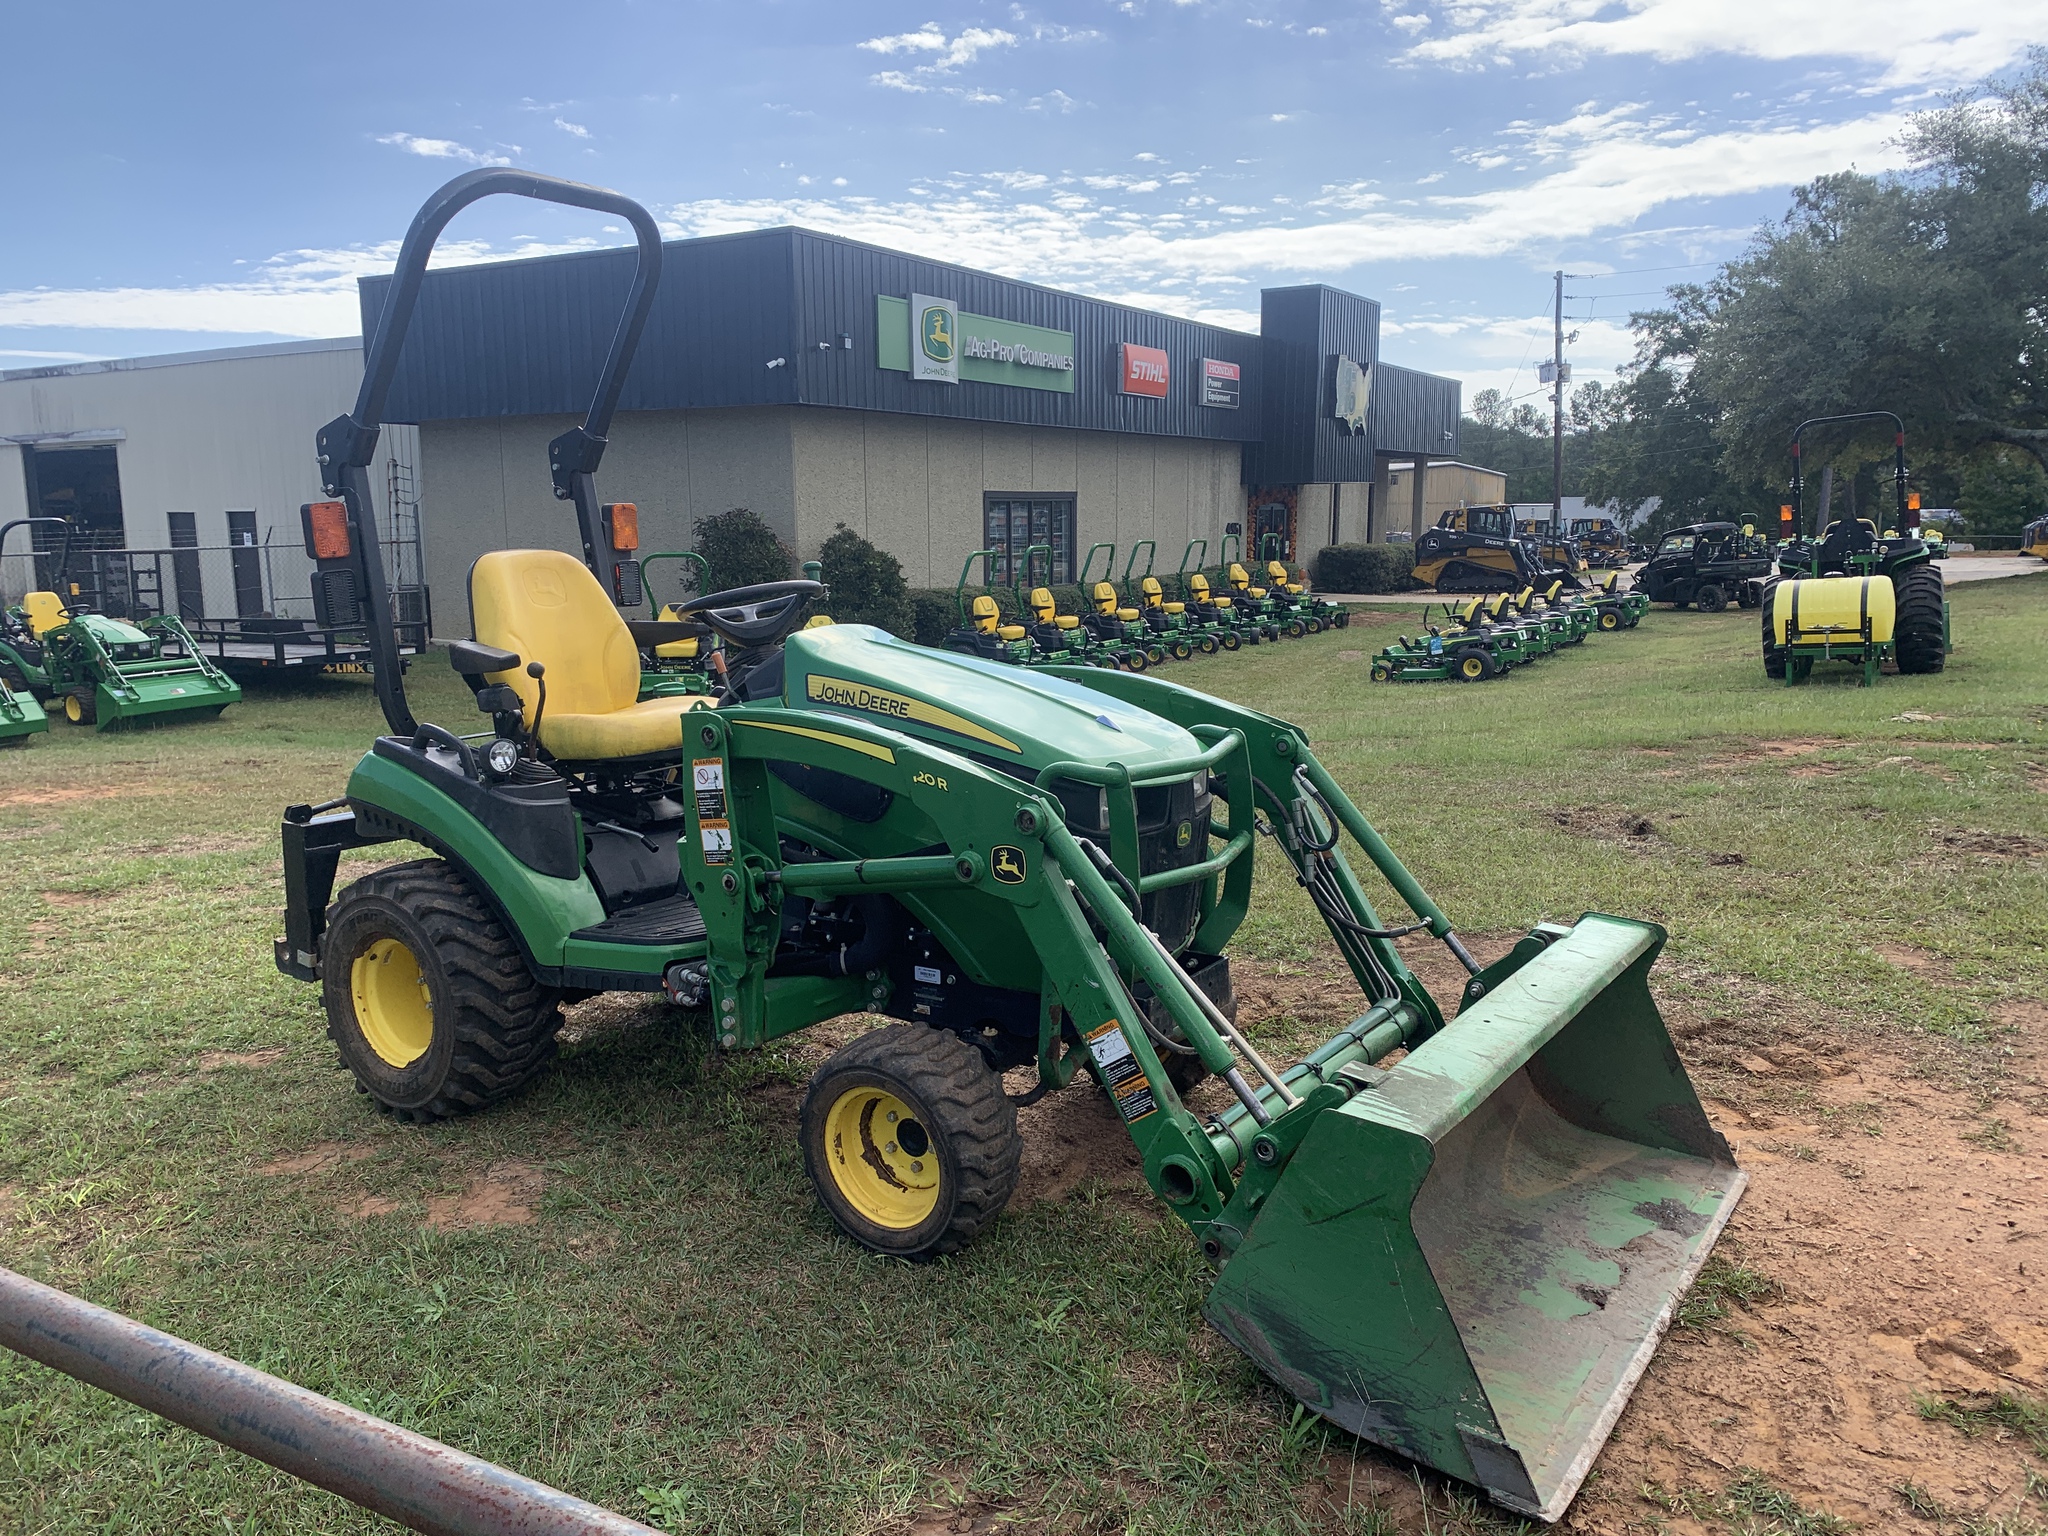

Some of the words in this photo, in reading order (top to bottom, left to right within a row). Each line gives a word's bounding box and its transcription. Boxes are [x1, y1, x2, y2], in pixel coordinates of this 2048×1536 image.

[1019, 344, 1074, 371] COMPANIES
[922, 366, 940, 375] JOHN
[1131, 360, 1165, 383] STIHL
[1208, 363, 1234, 377] HONDA
[1208, 378, 1223, 388] Power
[1208, 391, 1231, 402] Equipment
[1484, 538, 1505, 546] DEERE
[335, 663, 365, 673] LINX
[816, 683, 856, 705] JOHN
[858, 690, 910, 717] DEERE
[698, 758, 721, 766] WARNING
[704, 821, 728, 829] WARNING
[1092, 1022, 1115, 1038] WARNING
[1121, 1080, 1146, 1096] WARNING
